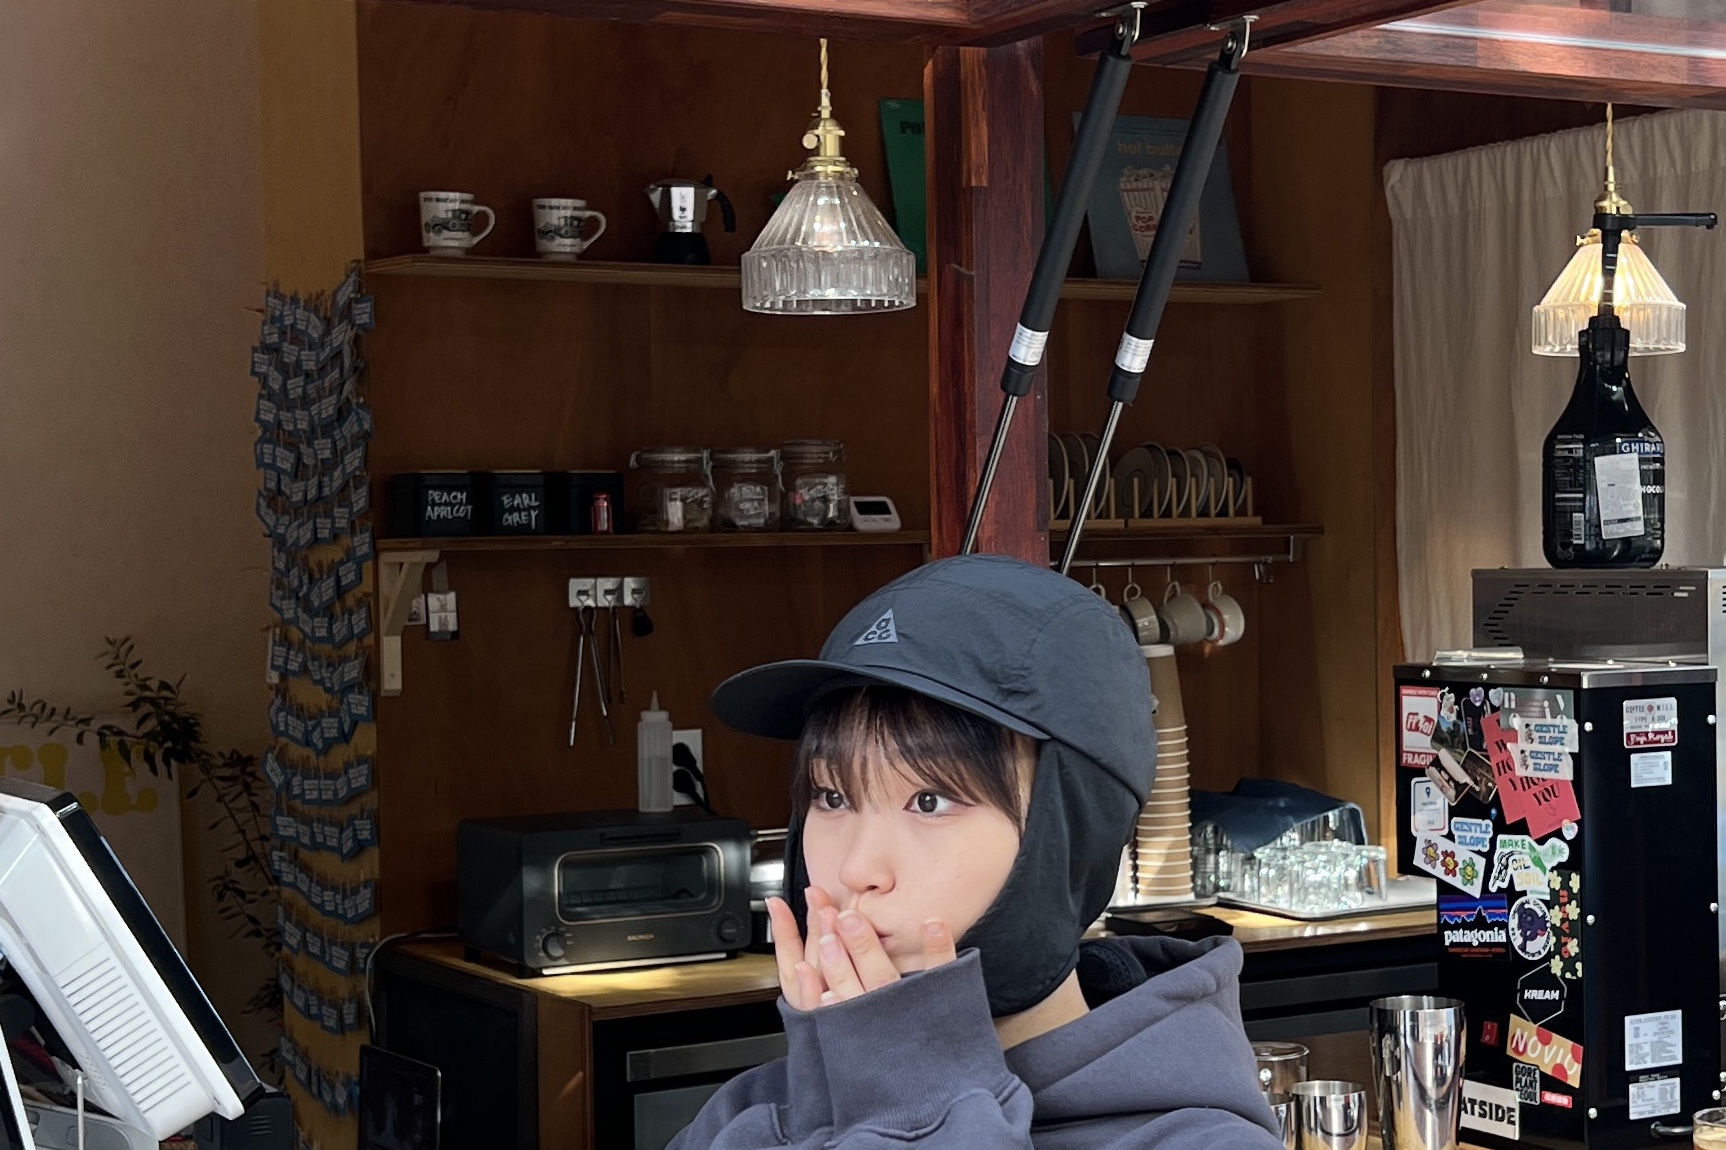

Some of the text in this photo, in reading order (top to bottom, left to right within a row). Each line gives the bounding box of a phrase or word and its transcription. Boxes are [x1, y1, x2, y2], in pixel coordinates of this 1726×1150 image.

[427, 490, 467, 505] PEACH
[501, 492, 541, 509] EARL
[425, 505, 473, 521] APRICOT
[501, 509, 539, 530] GREY
[1532, 783, 1560, 806] YOU
[1499, 838, 1527, 850] MAKE
[1443, 926, 1507, 947] patagonia
[1523, 989, 1560, 1001] KREAM
[1515, 1076, 1538, 1091] PLANT
